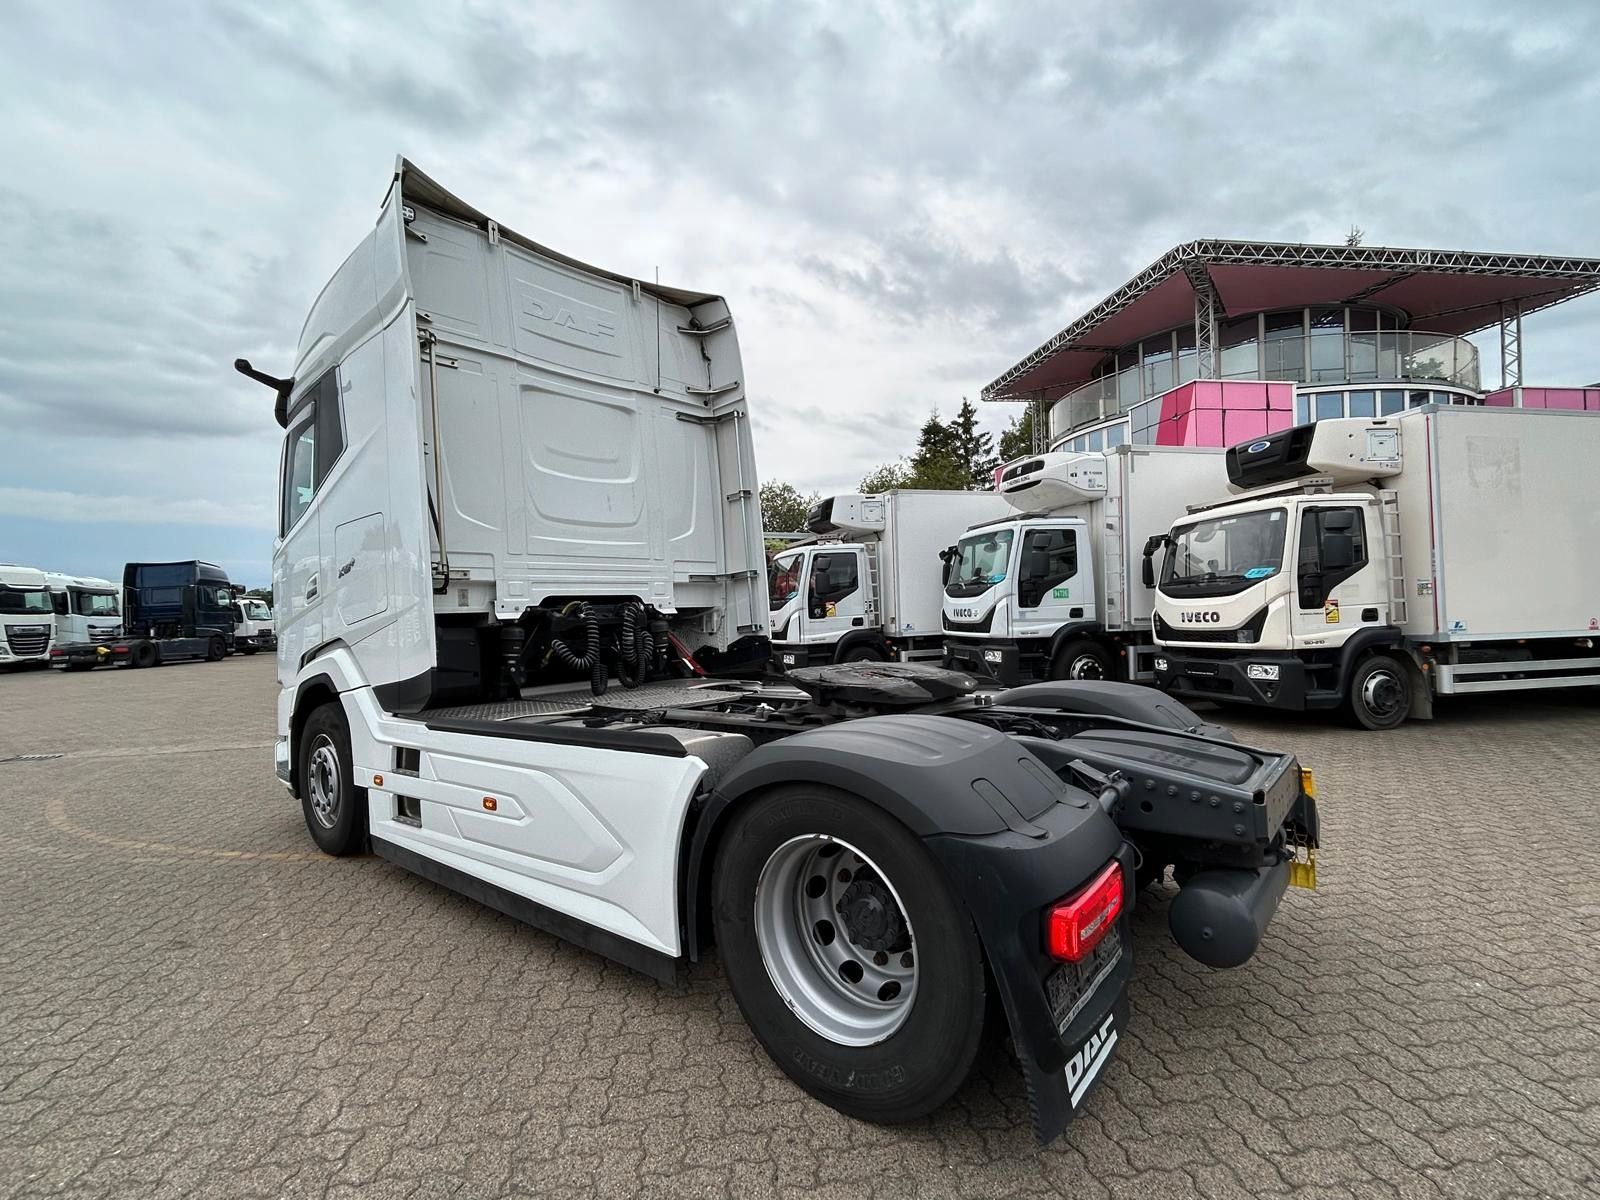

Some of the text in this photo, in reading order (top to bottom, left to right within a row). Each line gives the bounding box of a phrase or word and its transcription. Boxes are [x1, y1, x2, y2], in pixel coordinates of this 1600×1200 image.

[522, 299, 615, 338] DAF
[953, 608, 972, 618] IVECO
[1181, 611, 1220, 623] IVECO
[1064, 1012, 1115, 1094] DAF
